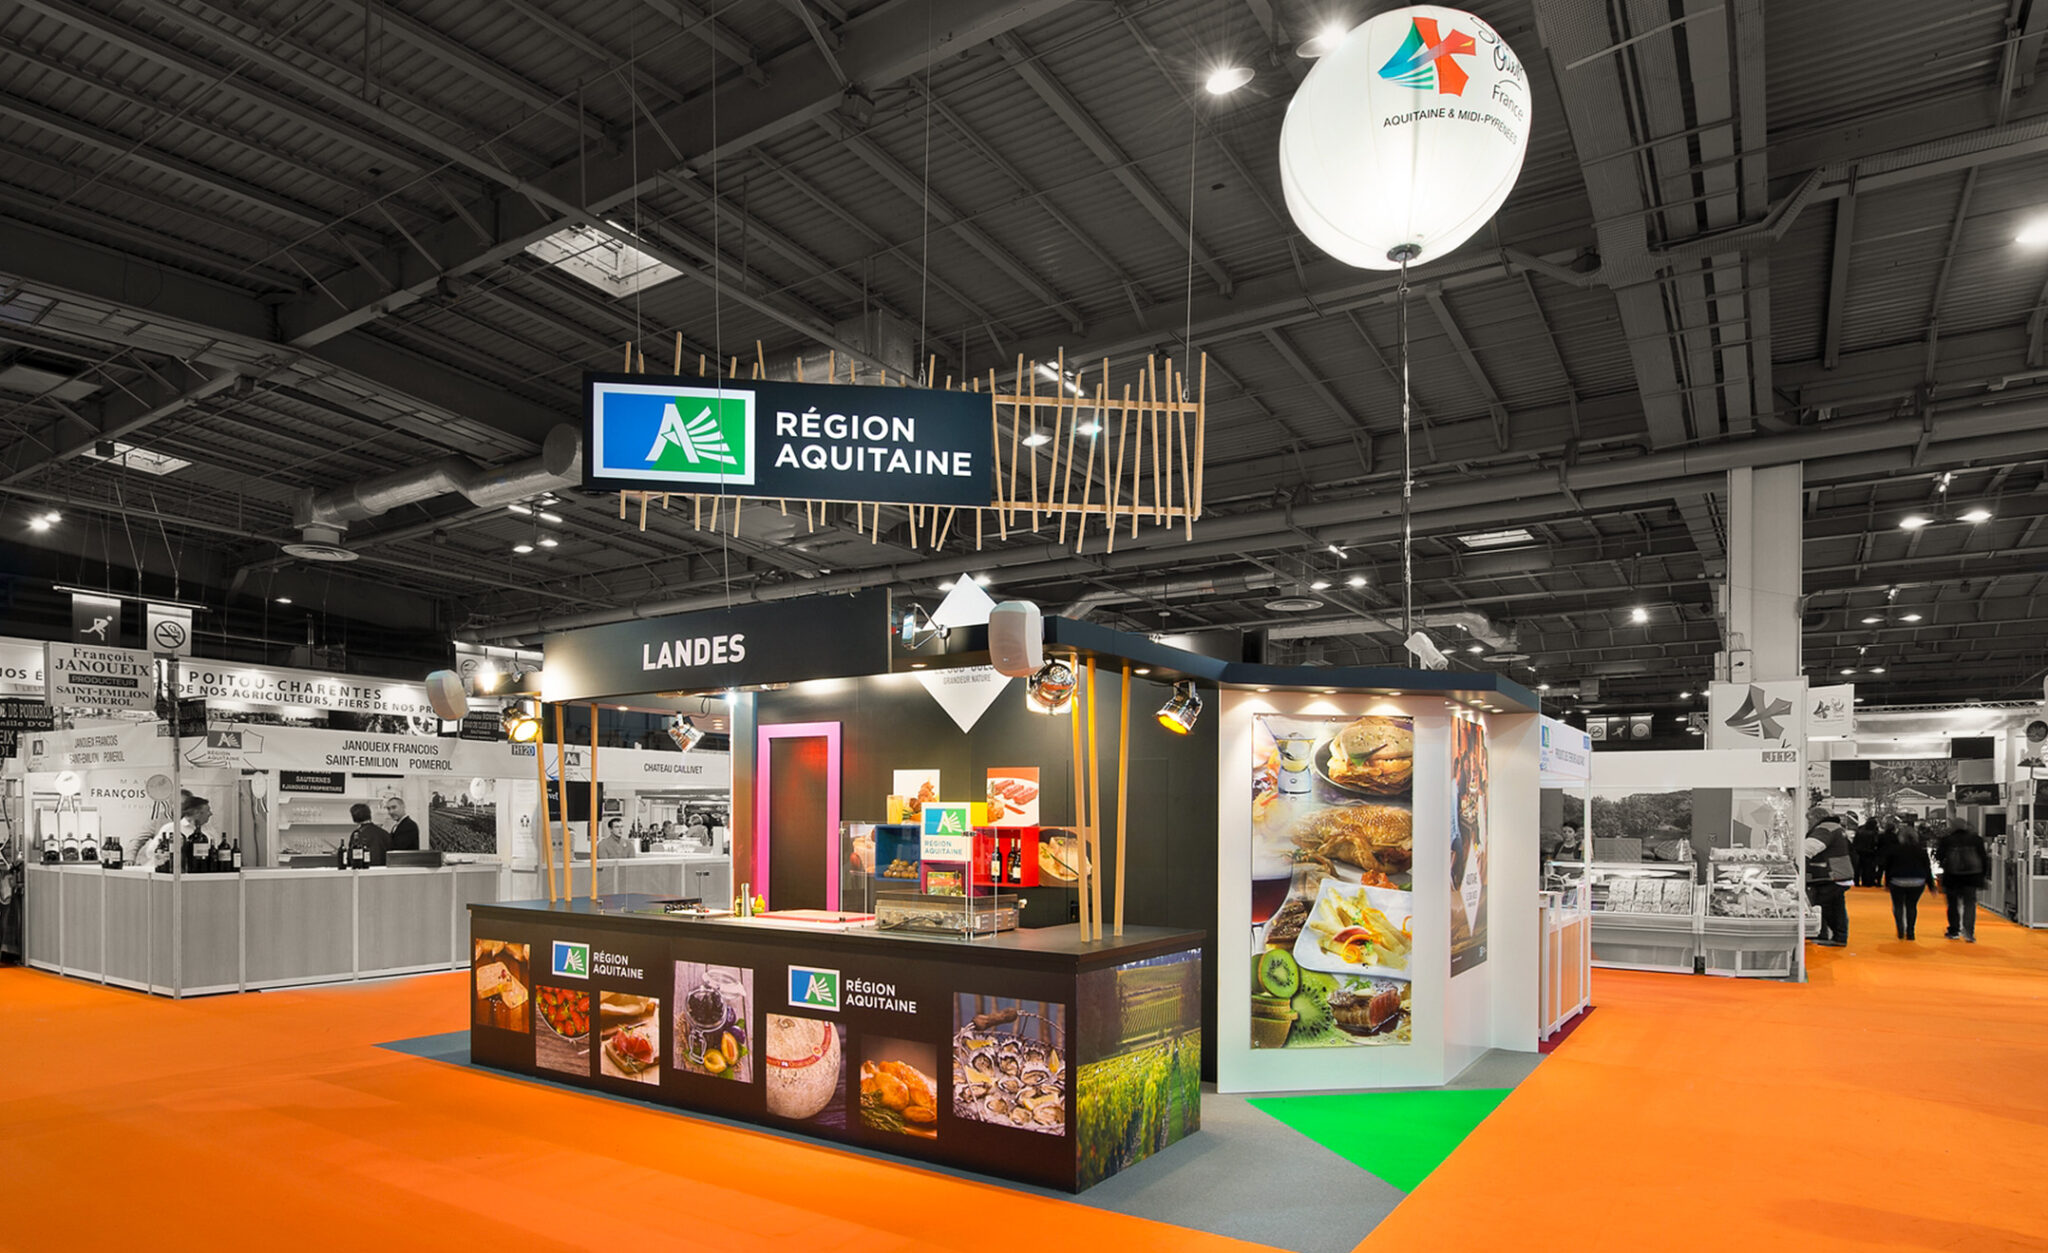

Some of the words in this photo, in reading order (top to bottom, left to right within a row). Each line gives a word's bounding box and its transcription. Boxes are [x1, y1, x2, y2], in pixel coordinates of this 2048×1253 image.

[1491, 84, 1524, 121] France
[1383, 108, 1446, 128] AQUITAINE
[1447, 108, 1455, 119] &
[775, 406, 916, 443] RÉGION
[774, 443, 973, 477] AQUITAINE
[73, 648, 135, 663] François
[642, 633, 746, 671] LANDES
[55, 659, 150, 677] JANOUEIX
[71, 675, 136, 687] PRODUCTEUR
[189, 671, 382, 699] POITOU-CHARENTES
[56, 685, 150, 699] SAINT-EMILION
[199, 685, 228, 697] NOS
[338, 698, 370, 710] FIERS
[374, 701, 388, 711] DE
[392, 703, 415, 713] NOS
[75, 695, 134, 707] POMEROL
[342, 740, 390, 753] JANOUEIX
[393, 743, 439, 756] FRANCOIS
[326, 755, 399, 769] SAINT-EMILION
[409, 759, 453, 771] POMEROL
[1766, 751, 1796, 762] J112
[643, 762, 673, 774] CHATEAU
[295, 775, 332, 784] SAUTERNES
[90, 788, 146, 799] FRANÇOIS
[593, 950, 629, 966] RÉGION
[592, 964, 645, 980] AQUITAINE
[845, 979, 896, 996] RÉGION
[845, 993, 917, 1014] AQUITAINE
